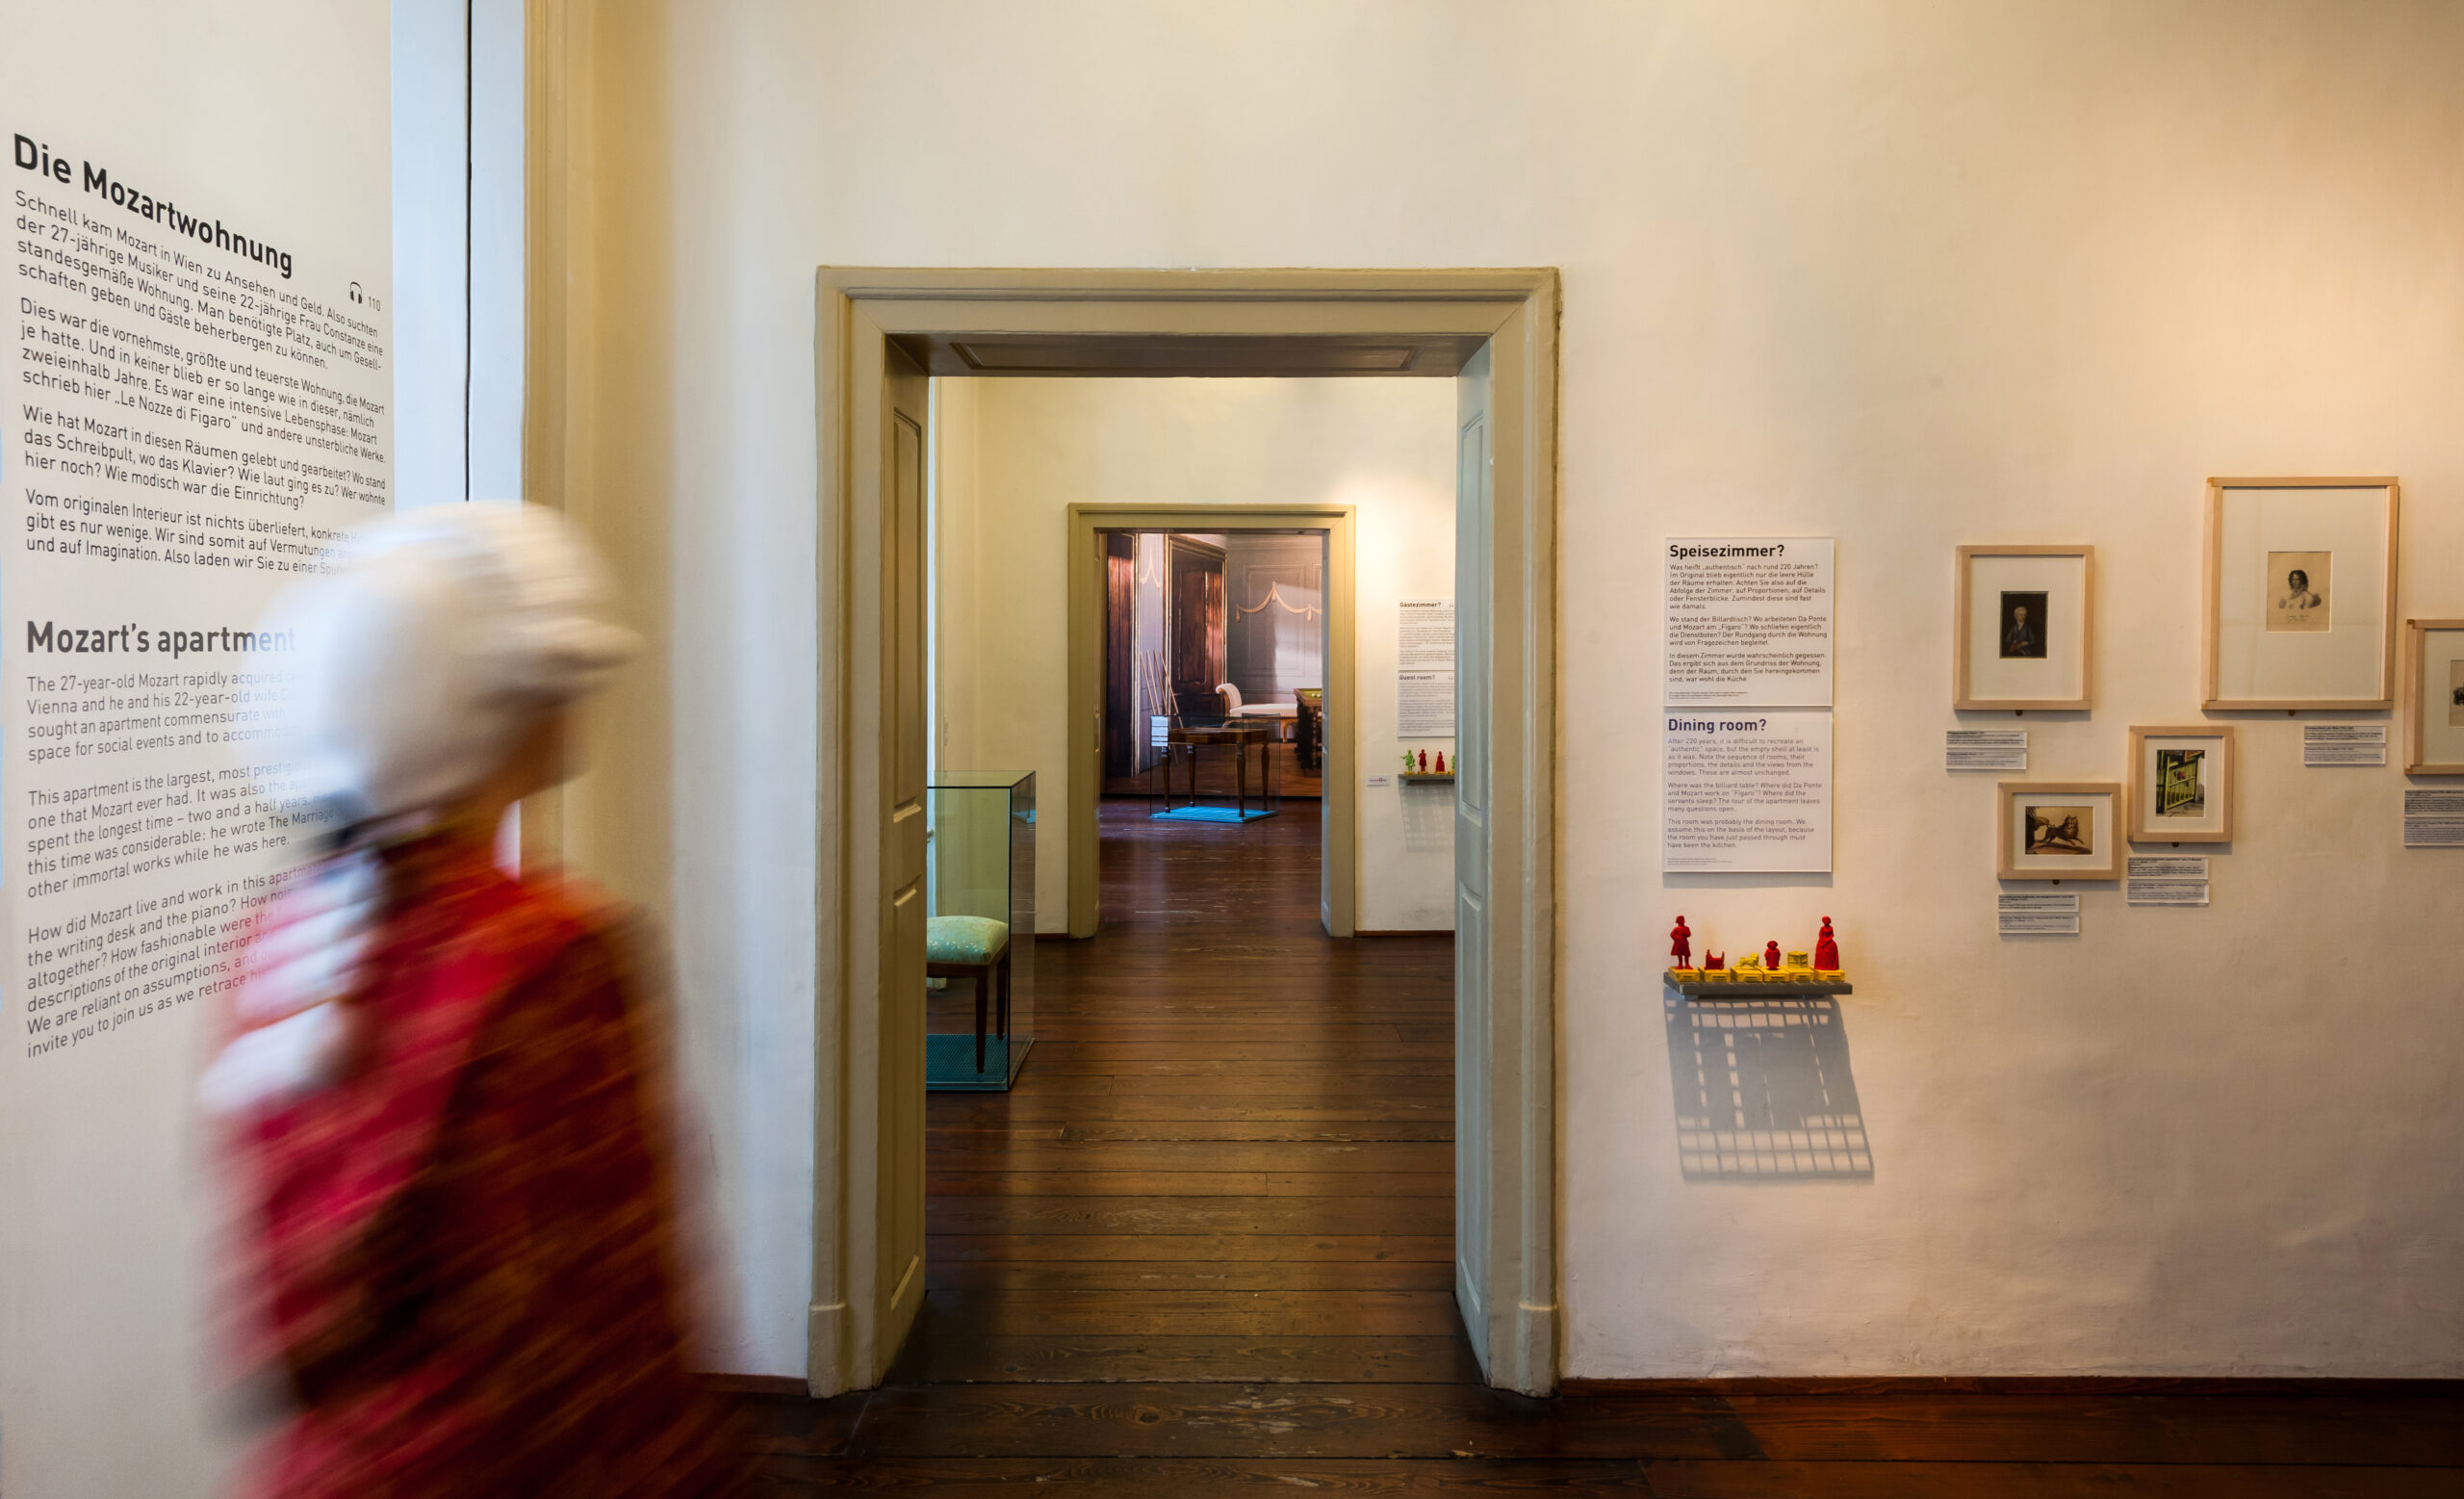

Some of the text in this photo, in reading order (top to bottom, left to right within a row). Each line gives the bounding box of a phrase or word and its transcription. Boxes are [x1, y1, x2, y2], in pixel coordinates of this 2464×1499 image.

[14, 133, 291, 279] Die Mozartwohnung
[15, 190, 377, 336] Schnell kam Mozart in Wien zu Ansehen und Geld. Also suchten
[16, 215, 382, 355] der 27-jährige Musiker und seine 22-jährige Frau Constanze eine
[17, 240, 381, 370] standesgemäße Wohnung. Man benötigte Platz, auch um Gesell-
[19, 264, 327, 368] schaften geben und Gäste beherbergen zu können.
[369, 297, 381, 312] 110
[23, 403, 385, 489] Wie hat Mozart in diesen Räumen gelebt und gearbeitet? Wo stand
[24, 428, 384, 505] das Schreibpult, wo das Klavier? Wie laut ging es zu? Wer wohnte
[25, 451, 303, 510] hier noch? Wie modisch war die Einrichtung?
[1670, 544, 1784, 559] Speisezimmer?
[157, 626, 295, 659] apartment
[27, 671, 227, 693] The 27-year-old Mozart rapidly
[27, 690, 248, 714] Vienna and he and his 22-year-old
[28, 719, 77, 739] sought
[80, 722, 95, 734] an
[99, 714, 160, 736] apartment
[1668, 718, 1767, 734] Dining room?
[28, 836, 288, 897] other immortal works while he was here.
[28, 894, 267, 967] the writing desk and the piano? How
[29, 875, 265, 943] How did Mozart live and work in this
